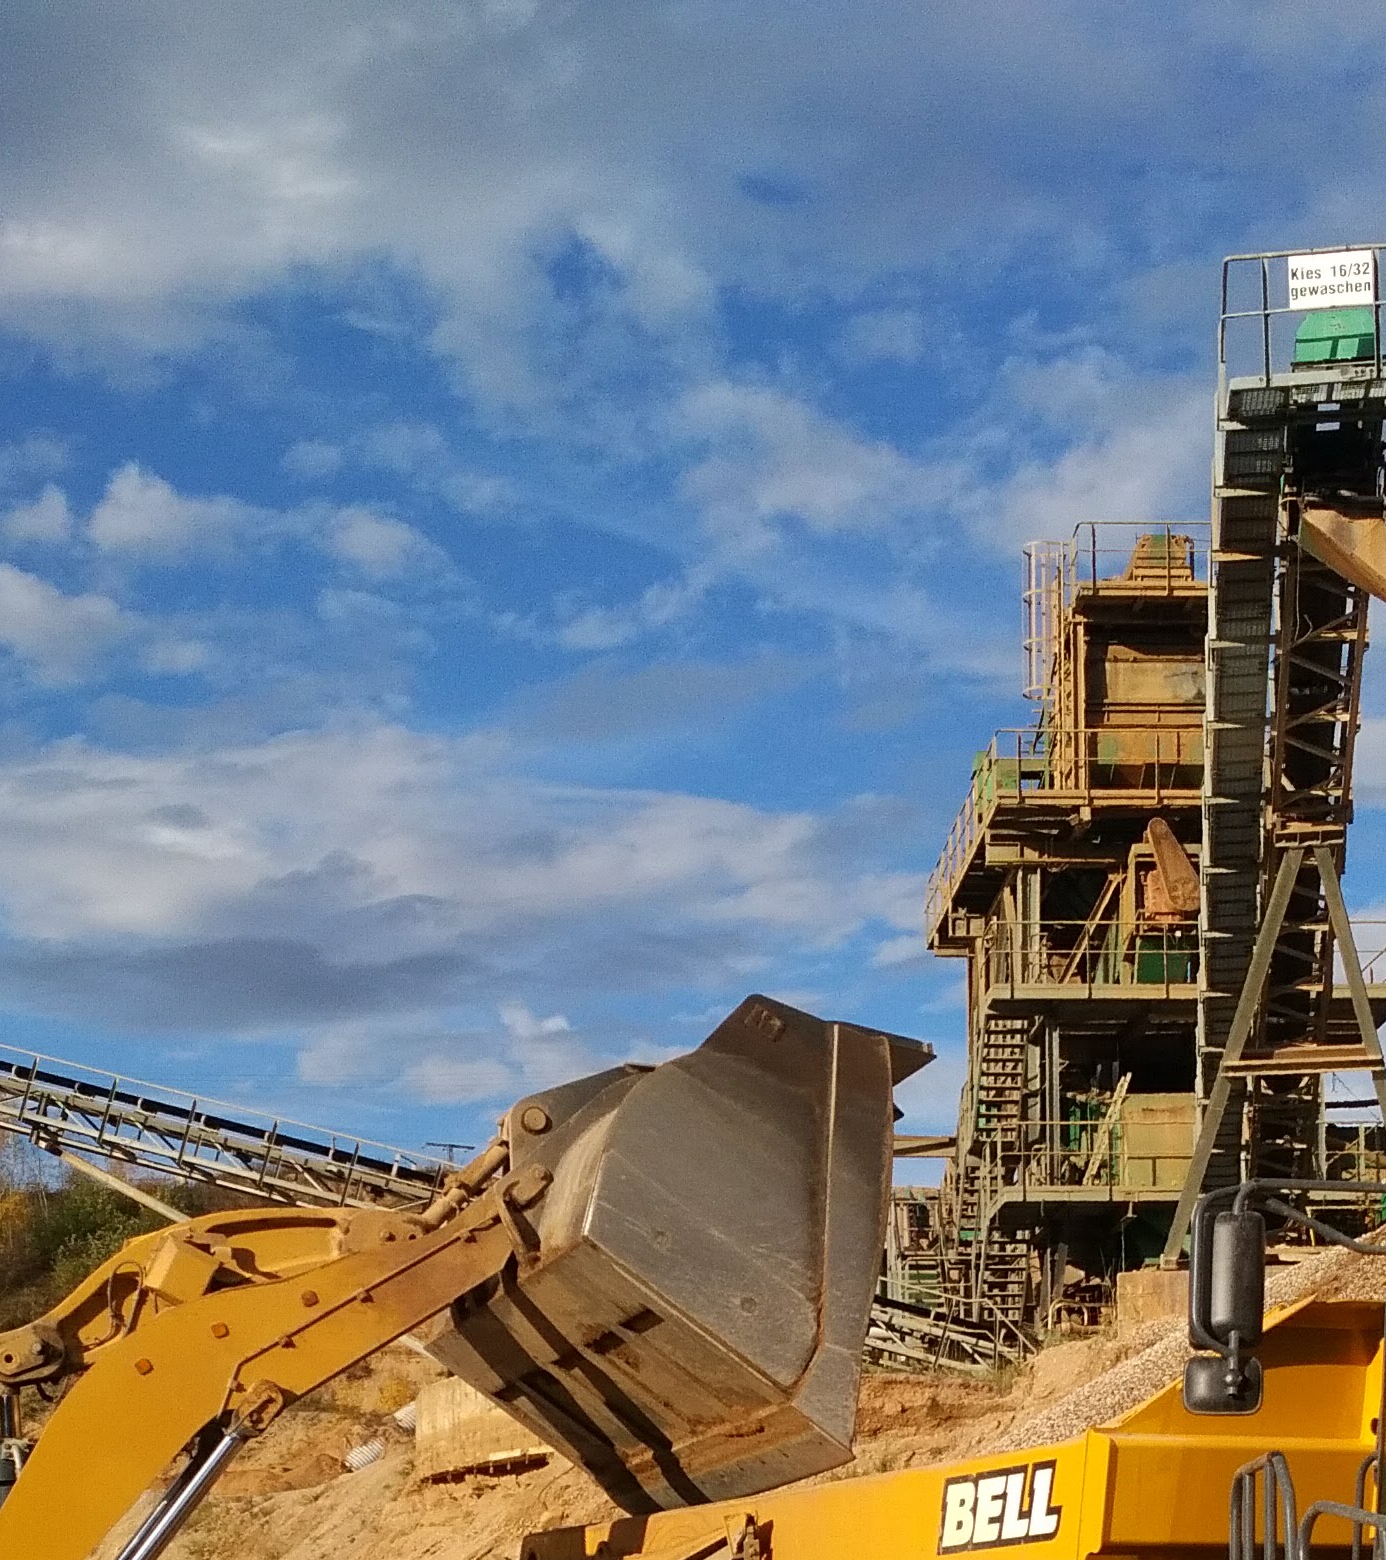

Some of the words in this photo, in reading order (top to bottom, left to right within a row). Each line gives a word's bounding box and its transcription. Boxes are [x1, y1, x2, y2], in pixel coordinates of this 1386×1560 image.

[1290, 267, 1322, 281] Kies
[1330, 261, 1370, 278] 16/32
[1290, 280, 1371, 301] gewaschen
[939, 1463, 1061, 1553] BELL
